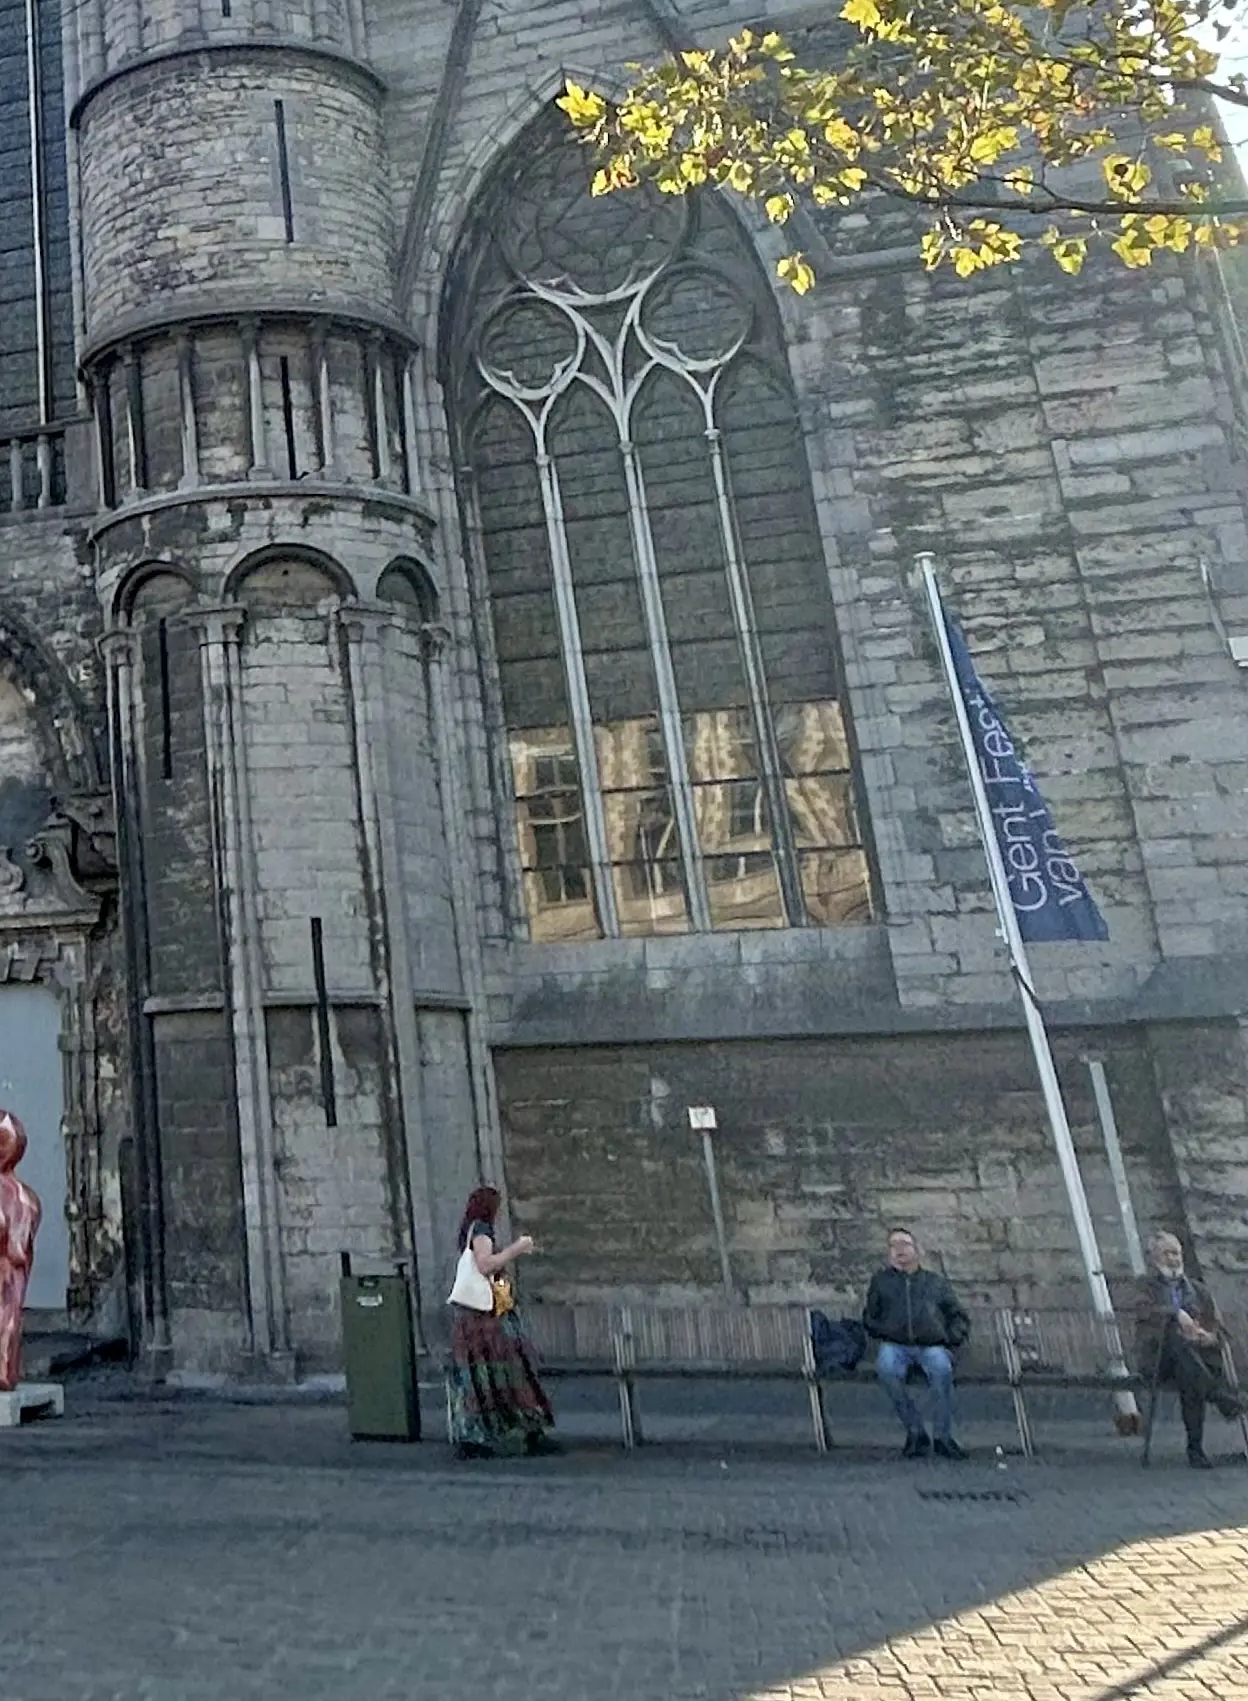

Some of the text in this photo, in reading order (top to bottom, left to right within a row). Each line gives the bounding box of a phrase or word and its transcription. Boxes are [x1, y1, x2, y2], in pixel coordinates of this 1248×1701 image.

[965, 688, 1021, 784] Fest
[992, 800, 1048, 913] Gent
[1042, 829, 1083, 906] van
